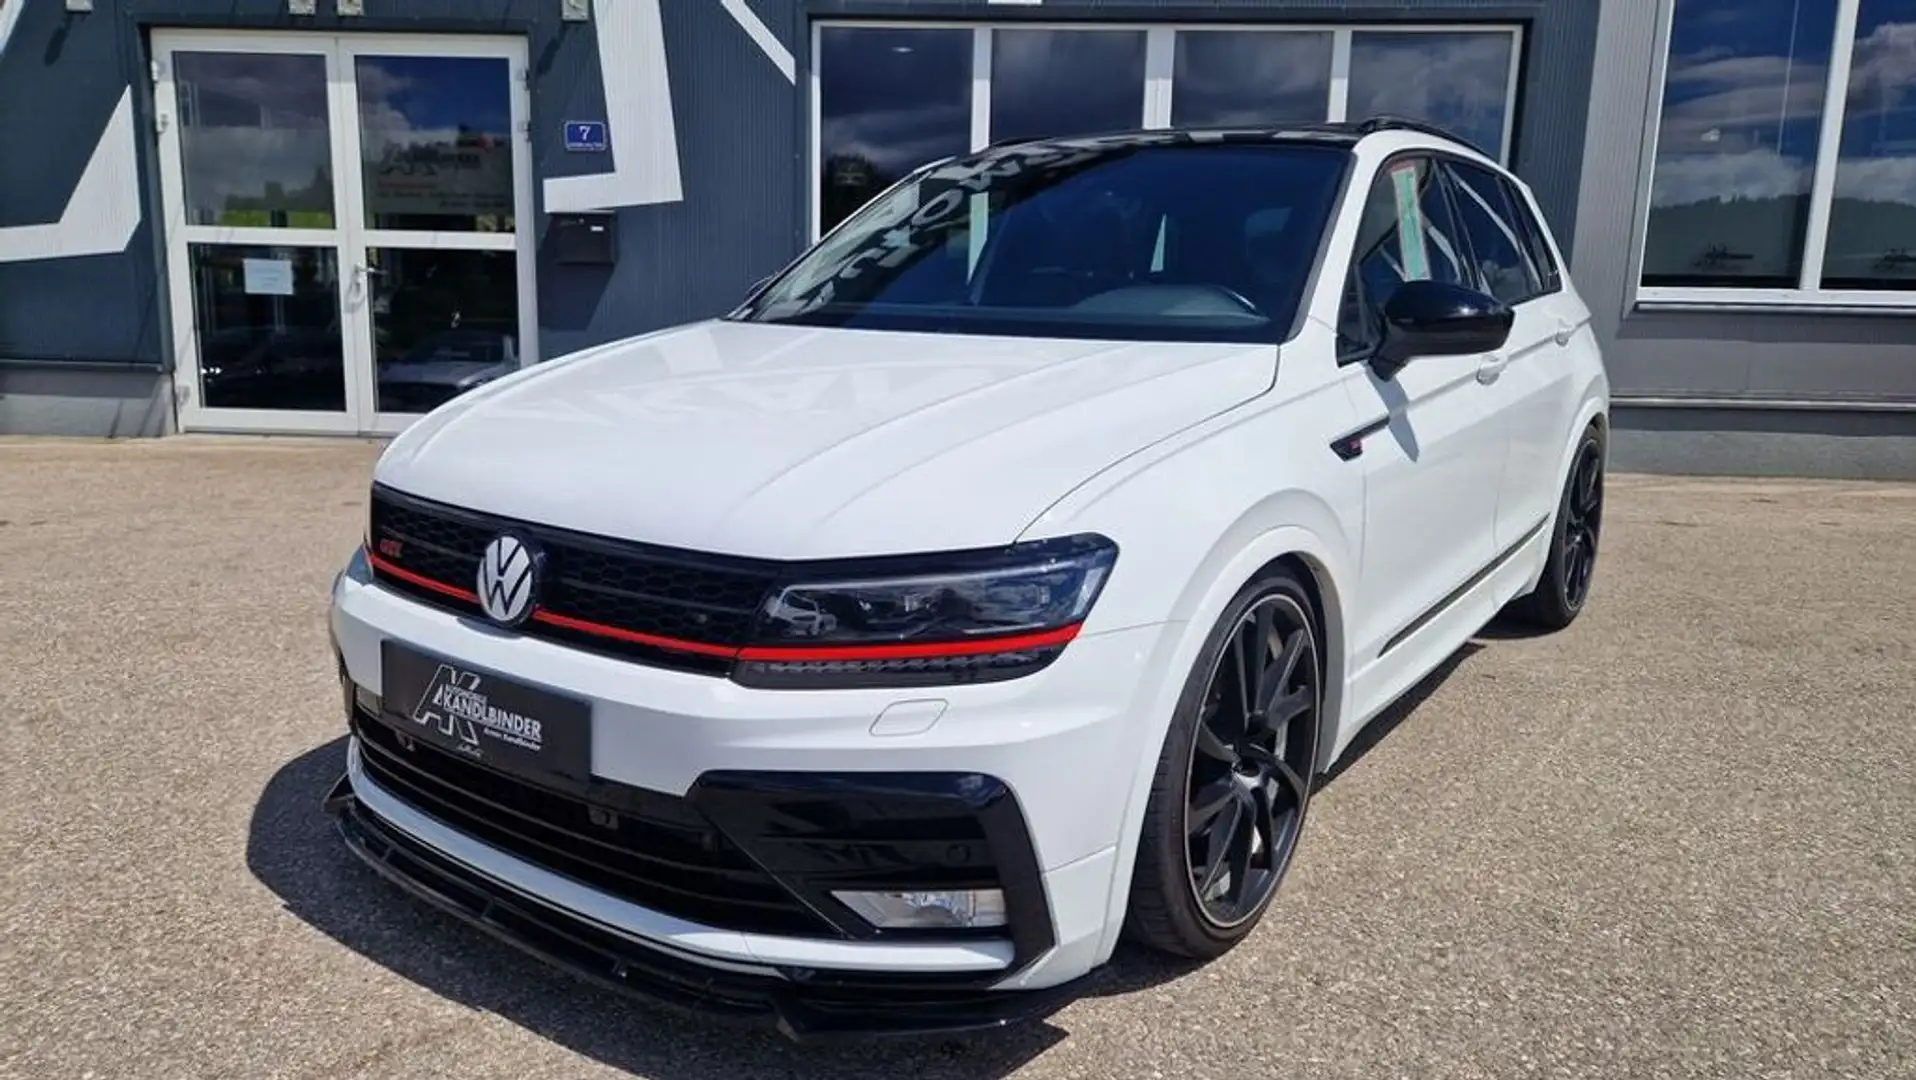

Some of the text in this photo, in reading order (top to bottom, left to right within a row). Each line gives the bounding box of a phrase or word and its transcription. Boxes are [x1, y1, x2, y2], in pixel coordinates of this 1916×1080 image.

[579, 125, 591, 141] 7
[476, 535, 533, 622] VW
[442, 690, 543, 739] KANDLBINDER
